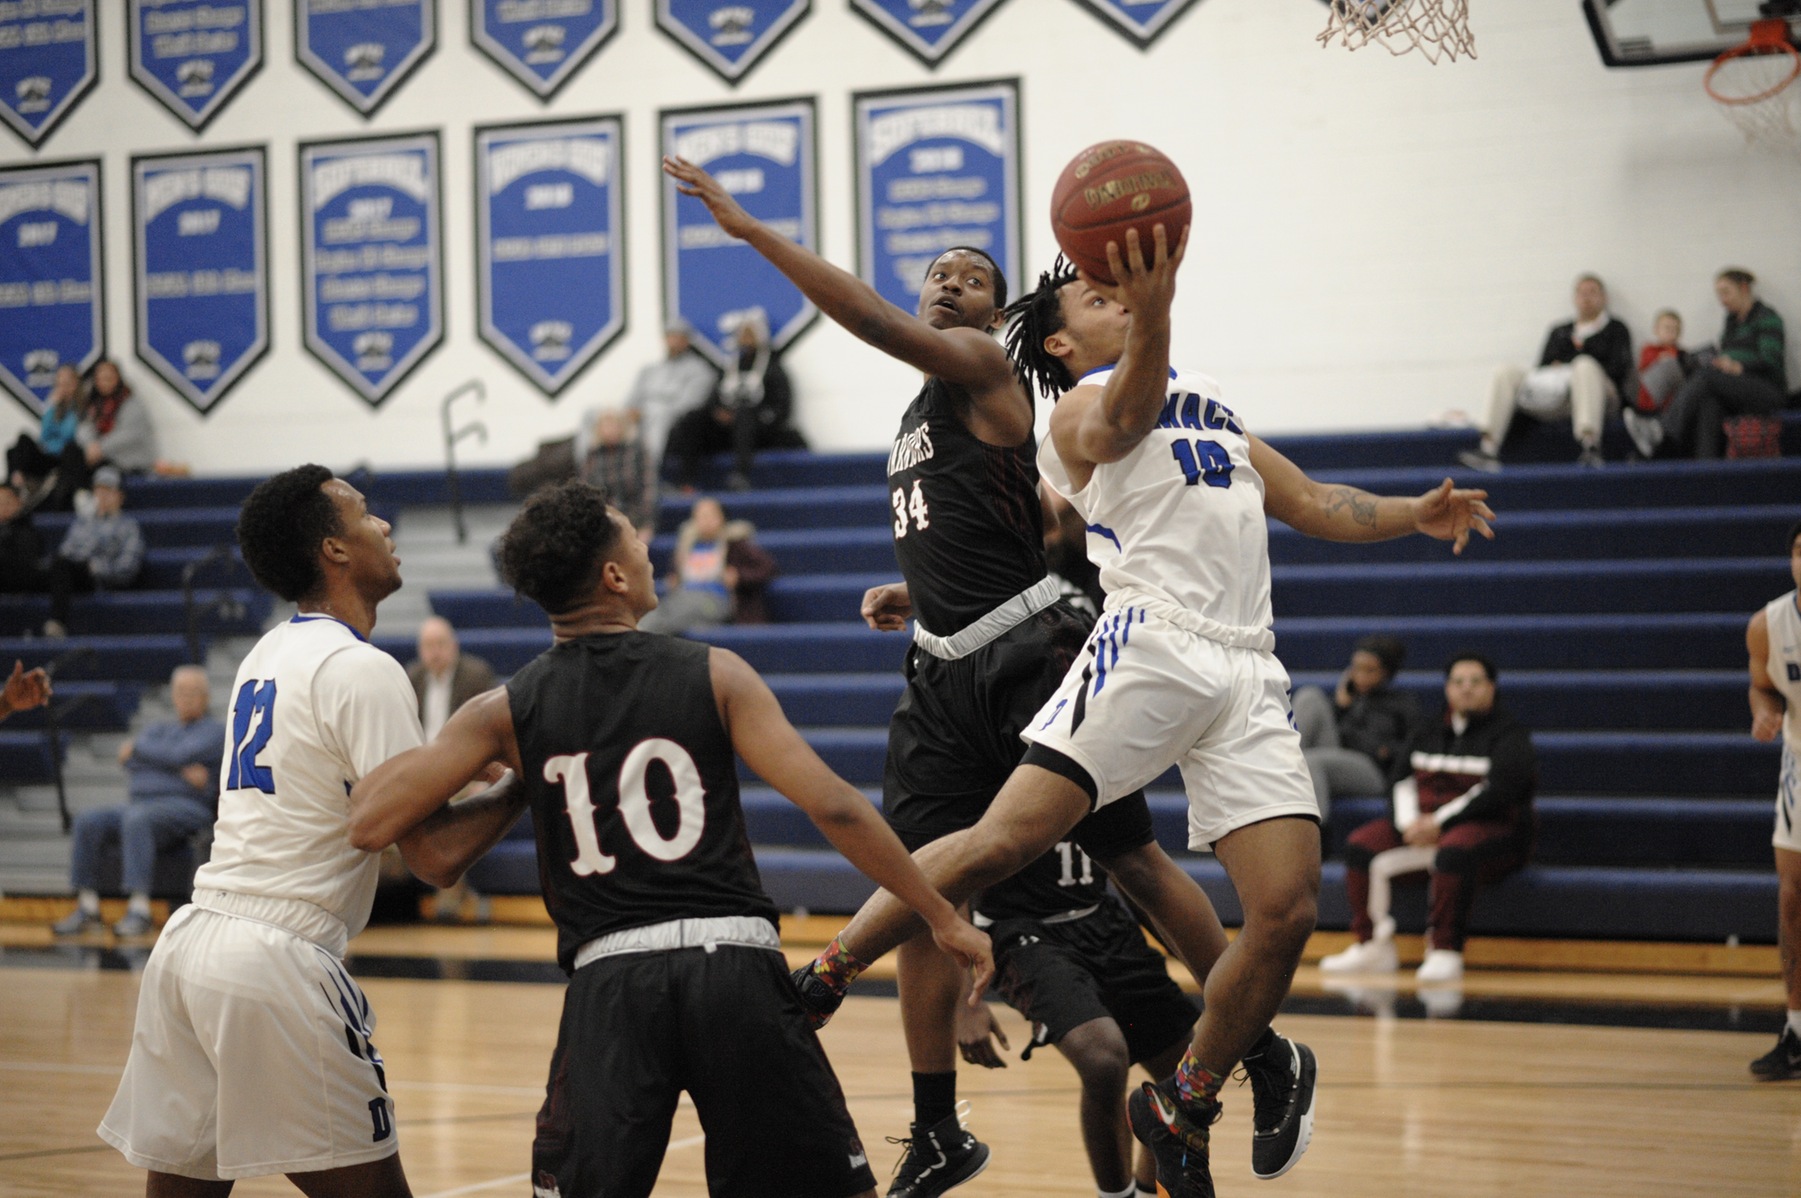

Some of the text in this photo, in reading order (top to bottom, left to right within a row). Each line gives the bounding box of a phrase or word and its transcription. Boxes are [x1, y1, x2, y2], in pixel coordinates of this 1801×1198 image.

[1170, 438, 1235, 489] 10
[892, 479, 930, 540] 34
[226, 678, 277, 794] 12
[542, 737, 708, 877] 10
[1054, 841, 1094, 887] 11
[367, 1096, 392, 1142] D
